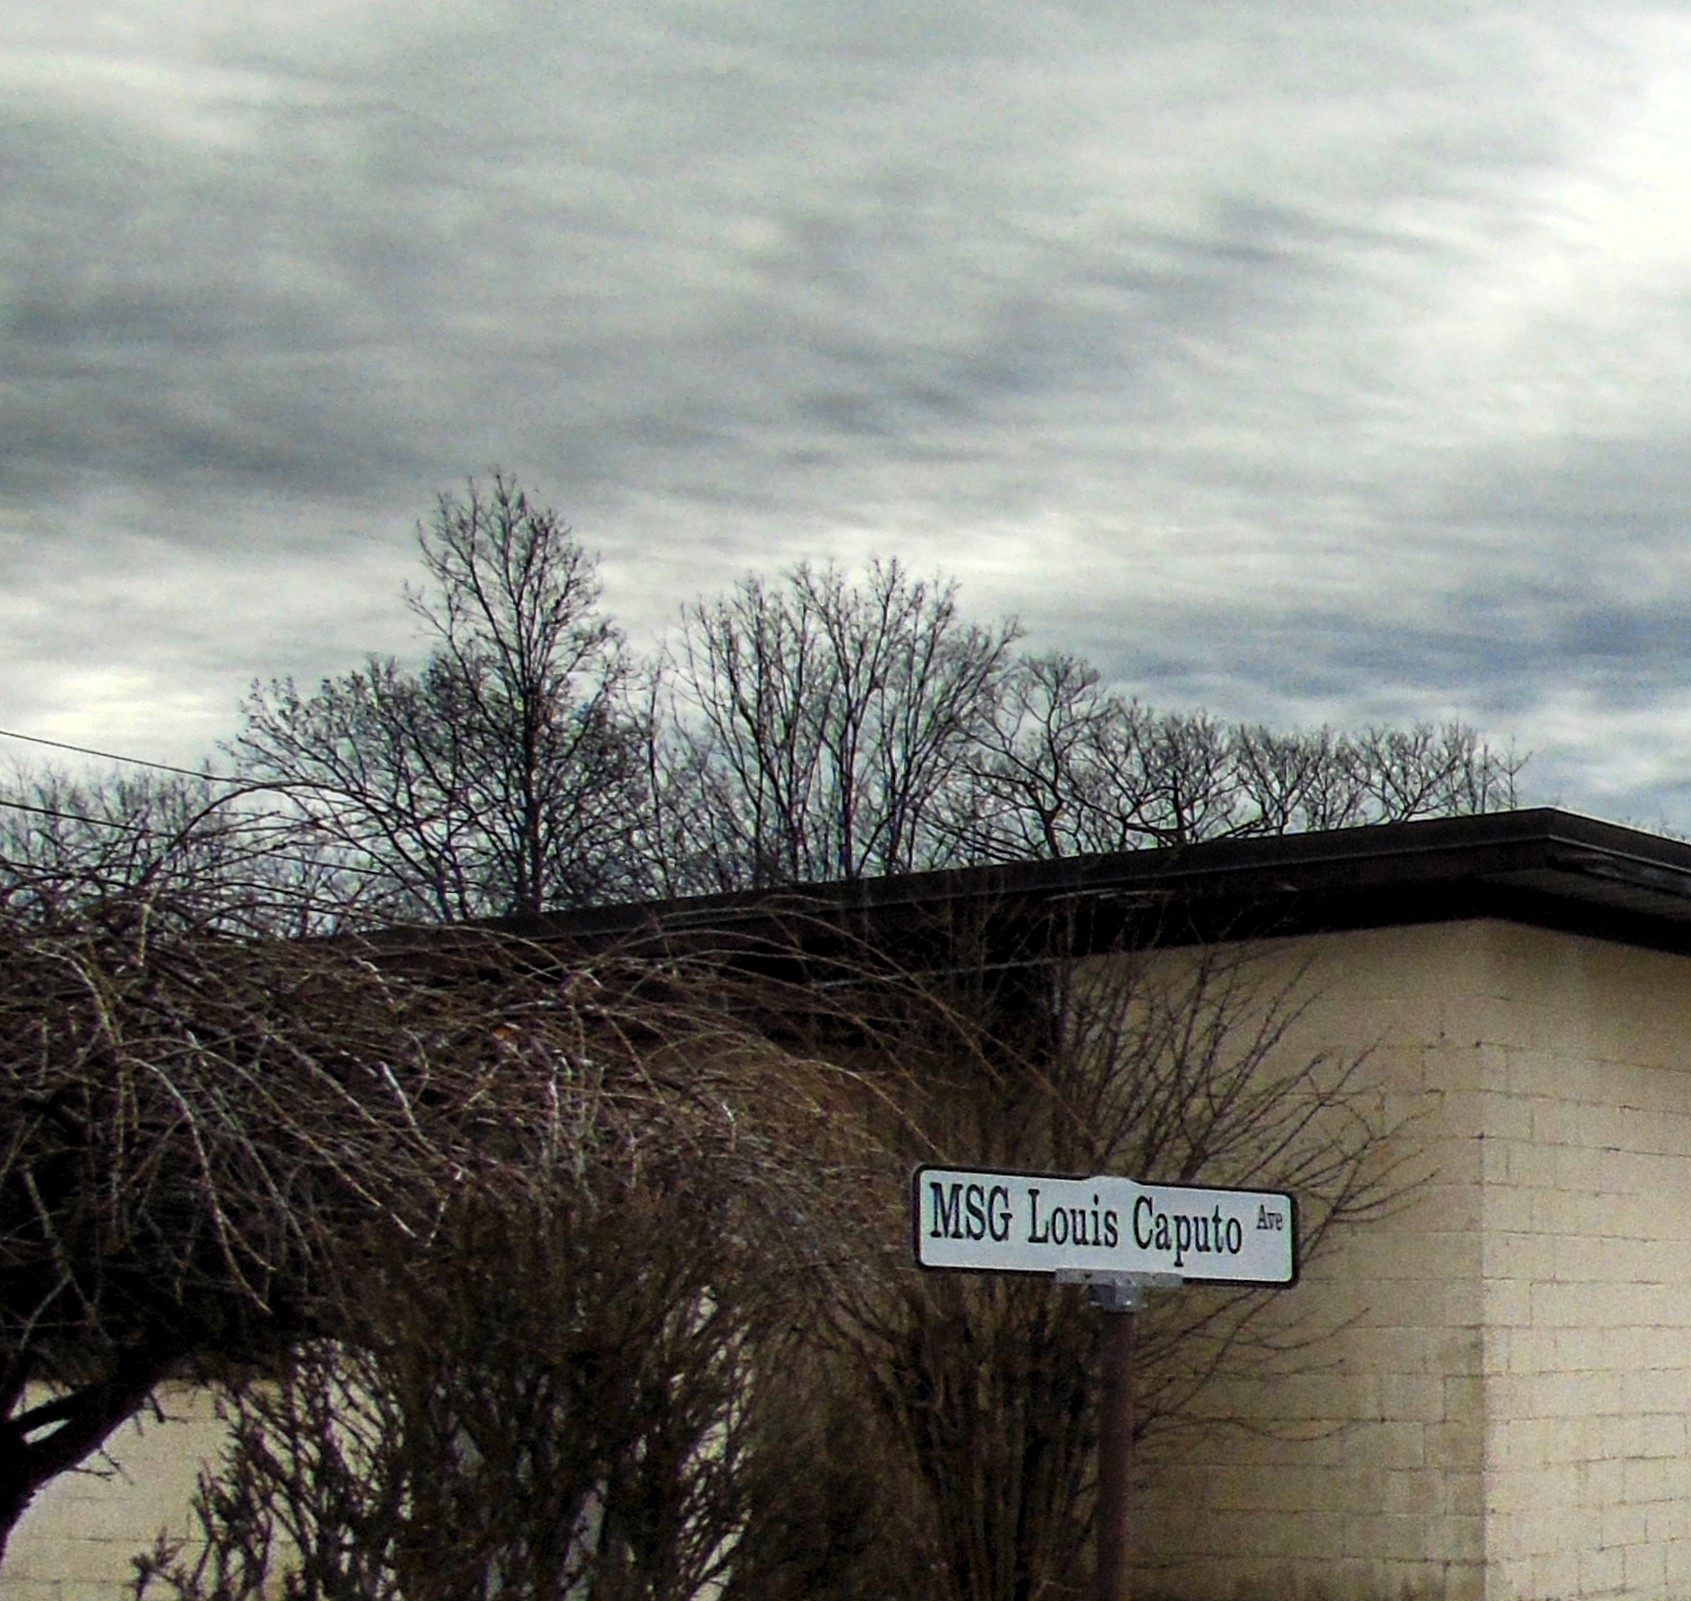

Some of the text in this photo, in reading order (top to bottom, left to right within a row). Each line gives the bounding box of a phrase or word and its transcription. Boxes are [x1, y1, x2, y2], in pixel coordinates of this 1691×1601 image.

[929, 1181, 1284, 1268] MSG Louis Caputo Ave
